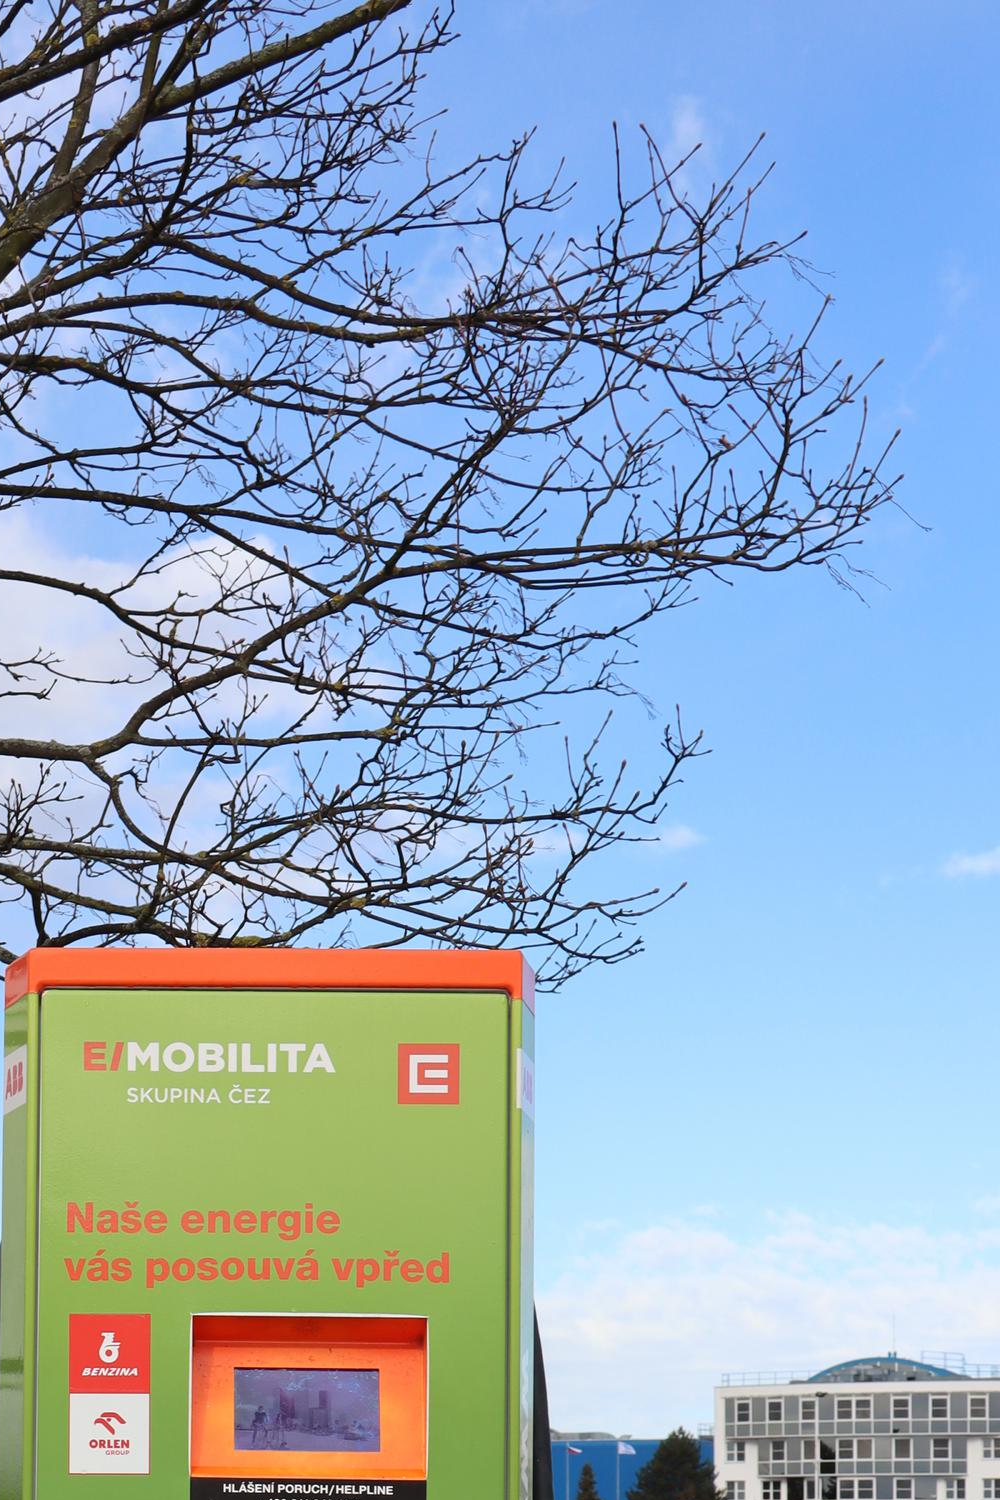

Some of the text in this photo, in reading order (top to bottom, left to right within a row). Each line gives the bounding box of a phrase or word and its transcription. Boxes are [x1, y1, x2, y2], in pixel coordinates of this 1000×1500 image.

[83, 1041, 336, 1073] E/MOBILITA
[5, 1061, 24, 1101] ABB
[126, 1083, 271, 1104] SKUPINA ČEZ
[66, 1201, 341, 1240] Naše energie
[64, 1250, 450, 1288] vás posouvá vpřed
[82, 1367, 138, 1376] BENZINA
[89, 1440, 130, 1448] ORLEN
[223, 1482, 274, 1494] HLÁŠENÍ
